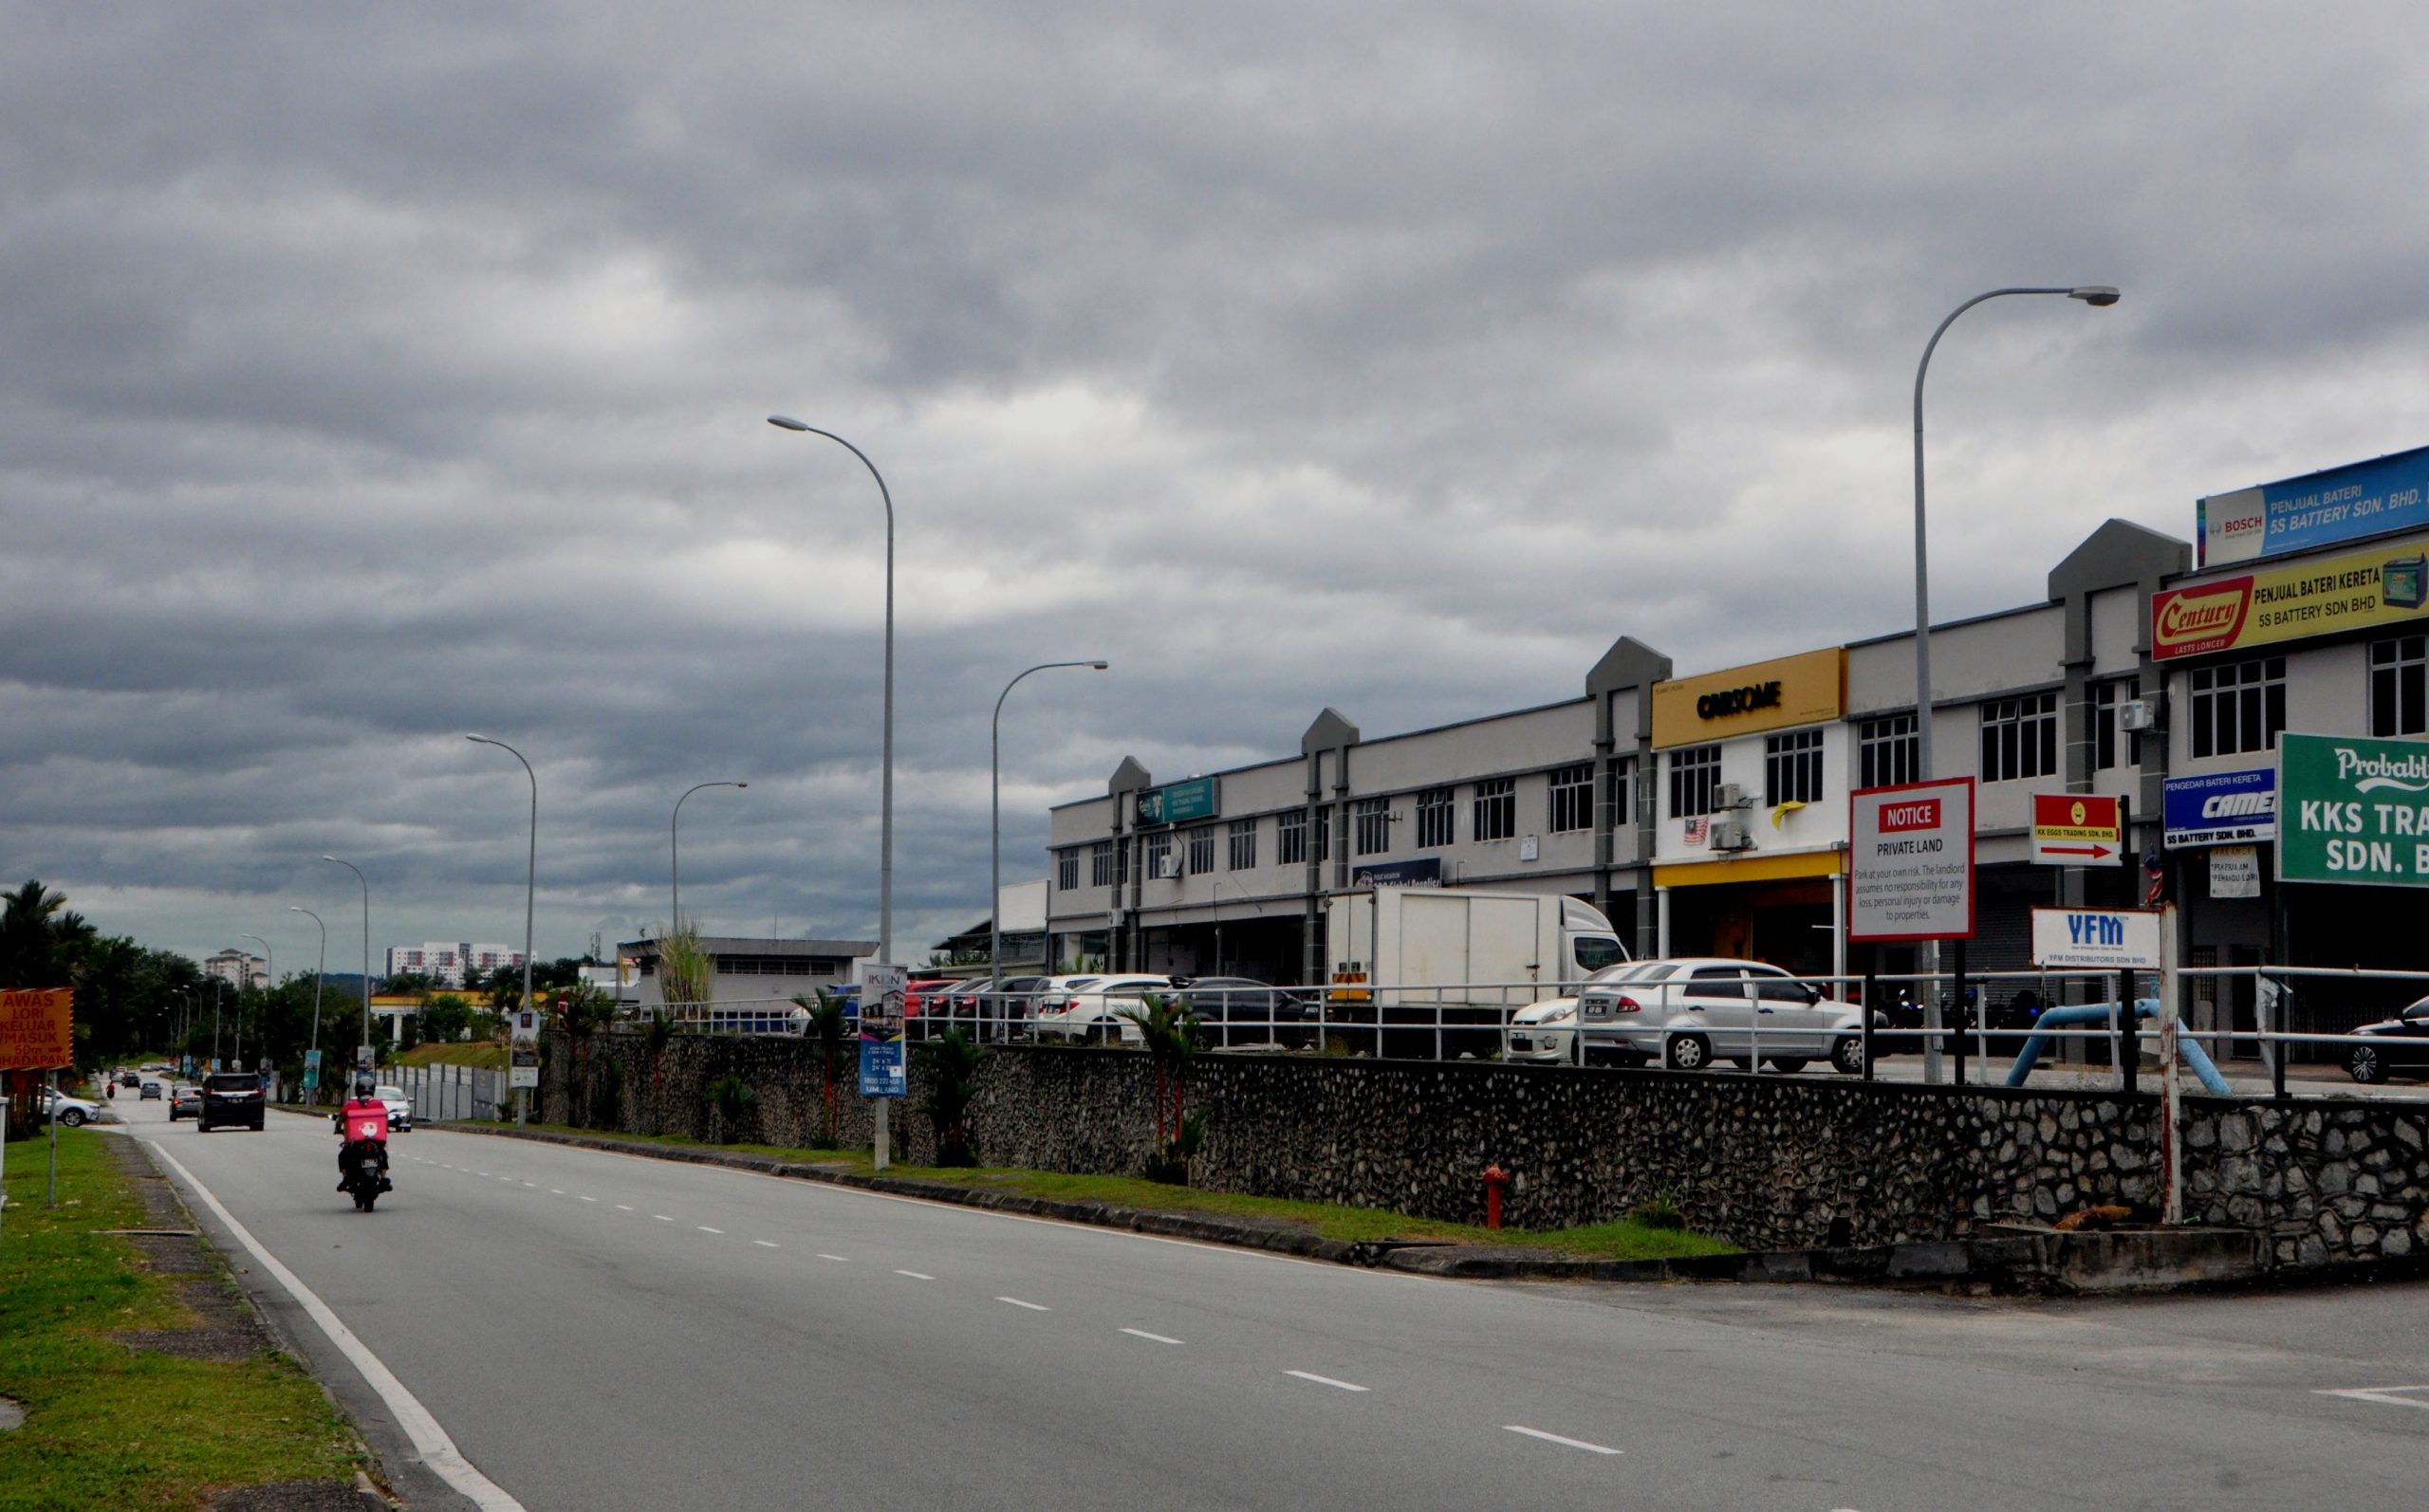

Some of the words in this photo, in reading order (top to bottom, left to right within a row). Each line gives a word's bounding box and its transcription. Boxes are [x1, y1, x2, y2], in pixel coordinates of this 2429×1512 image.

[2271, 497, 2320, 514] PENJUAL
[2323, 484, 2363, 504] BATERI
[2270, 518, 2286, 535] 5S
[2289, 504, 2350, 530] BATTERY
[2352, 497, 2384, 518] SDN.
[2388, 489, 2421, 510] BHD.
[2225, 516, 2263, 533] BOSCH
[2254, 588, 2298, 605] PENJUAL
[2301, 579, 2336, 597] BATERI
[2339, 567, 2381, 590] KERETA
[2161, 600, 2235, 637] Century
[2258, 613, 2271, 628] 5S
[2274, 604, 2323, 626] BATTERY
[2325, 599, 2348, 617] SDN
[2351, 596, 2376, 612] BHD
[2175, 643, 2196, 655] LASTS
[2197, 639, 2225, 653] LONGER
[2334, 748, 2429, 779] Probabl
[2166, 780, 2205, 791] PENGEDAR
[2206, 777, 2232, 788] BATERI
[2233, 774, 2261, 784] KERETA
[1887, 805, 1932, 826] NOTICE
[2301, 800, 2363, 833] KKS
[2064, 829, 2086, 838] TRADING
[2179, 832, 2214, 842] BATTERY
[2216, 830, 2234, 839] SDN.
[2237, 829, 2256, 839] BHD.
[1877, 840, 1914, 857] PRIVATE
[1917, 839, 1943, 853] LAND
[2326, 839, 2403, 874] SDN.
[1855, 870, 1867, 879] Park
[1868, 870, 1876, 878] at
[1877, 870, 1892, 880] your
[1893, 869, 1907, 877] own
[1922, 865, 1935, 876] The
[1936, 862, 1965, 875] landlord
[1856, 884, 1882, 894] assumes
[1884, 884, 1893, 893] no
[1894, 878, 1938, 894] responsibility
[1938, 877, 1949, 889] for
[1950, 878, 1963, 891] any
[1874, 896, 1901, 909] personal
[1903, 895, 1921, 909] injury
[1923, 896, 1931, 905] or
[1932, 894, 1960, 907] damage
[1886, 911, 1893, 920] to
[1895, 910, 1930, 923] properties.
[2067, 914, 2123, 945] YFM
[2065, 955, 2114, 964] DISTRIBUTORS
[3, 993, 54, 1007] AWAS
[13, 1008, 44, 1020] LORI
[0, 1020, 55, 1032] KELUAR
[15, 1044, 42, 1056] 50m
